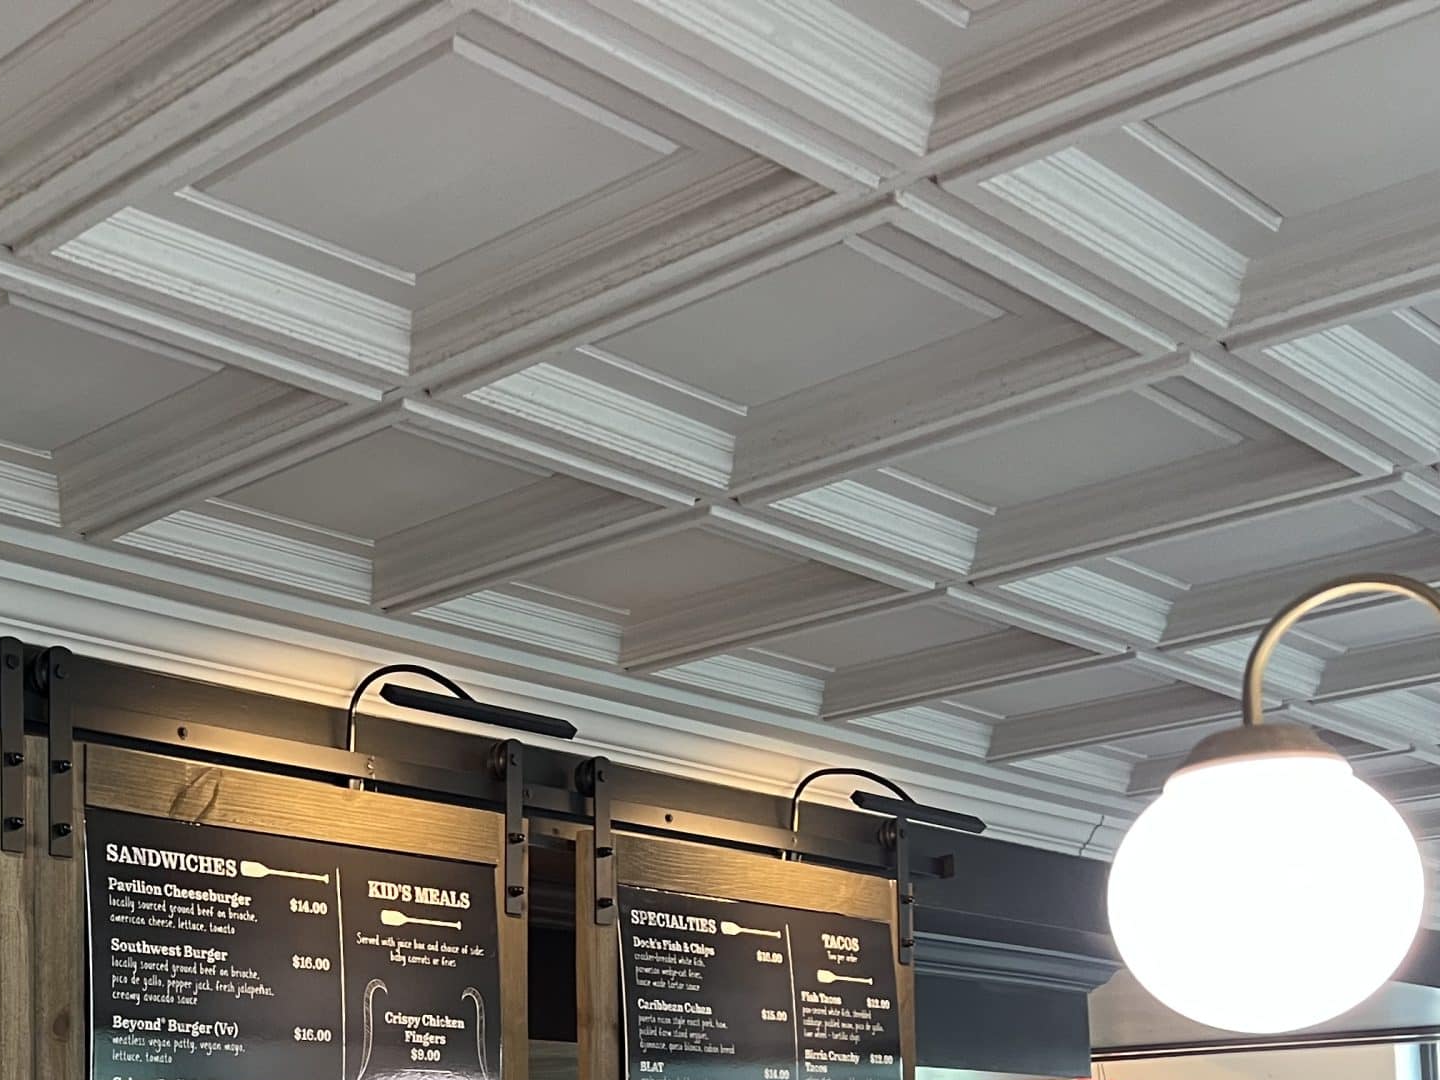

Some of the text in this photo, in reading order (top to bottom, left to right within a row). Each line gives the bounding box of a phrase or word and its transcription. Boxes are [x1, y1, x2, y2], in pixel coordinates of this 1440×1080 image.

[106, 843, 237, 878] SANDWICHES
[108, 877, 327, 915] Pavilion Cheeseburger $14.00
[368, 880, 470, 909] KID'S MEALS
[631, 909, 717, 934] SPECIALTIES
[633, 936, 715, 958] Dock's Fish & Chips
[821, 933, 860, 952] TACOS
[111, 938, 330, 971] Southwest Burger $16.00
[801, 991, 842, 1005] Fish Tacos
[385, 1011, 465, 1029] Crispy Chicken
[637, 998, 787, 1022] Caribbean Cuban $15.00
[168, 1019, 213, 1037] Burger
[214, 1021, 239, 1039] (Vv)
[294, 1027, 331, 1042] $16.00
[404, 1030, 446, 1047] Fingers
[411, 1047, 440, 1061] $9.00
[640, 1061, 790, 1080] BLAT $14.00
[804, 1061, 828, 1073] Tacos
